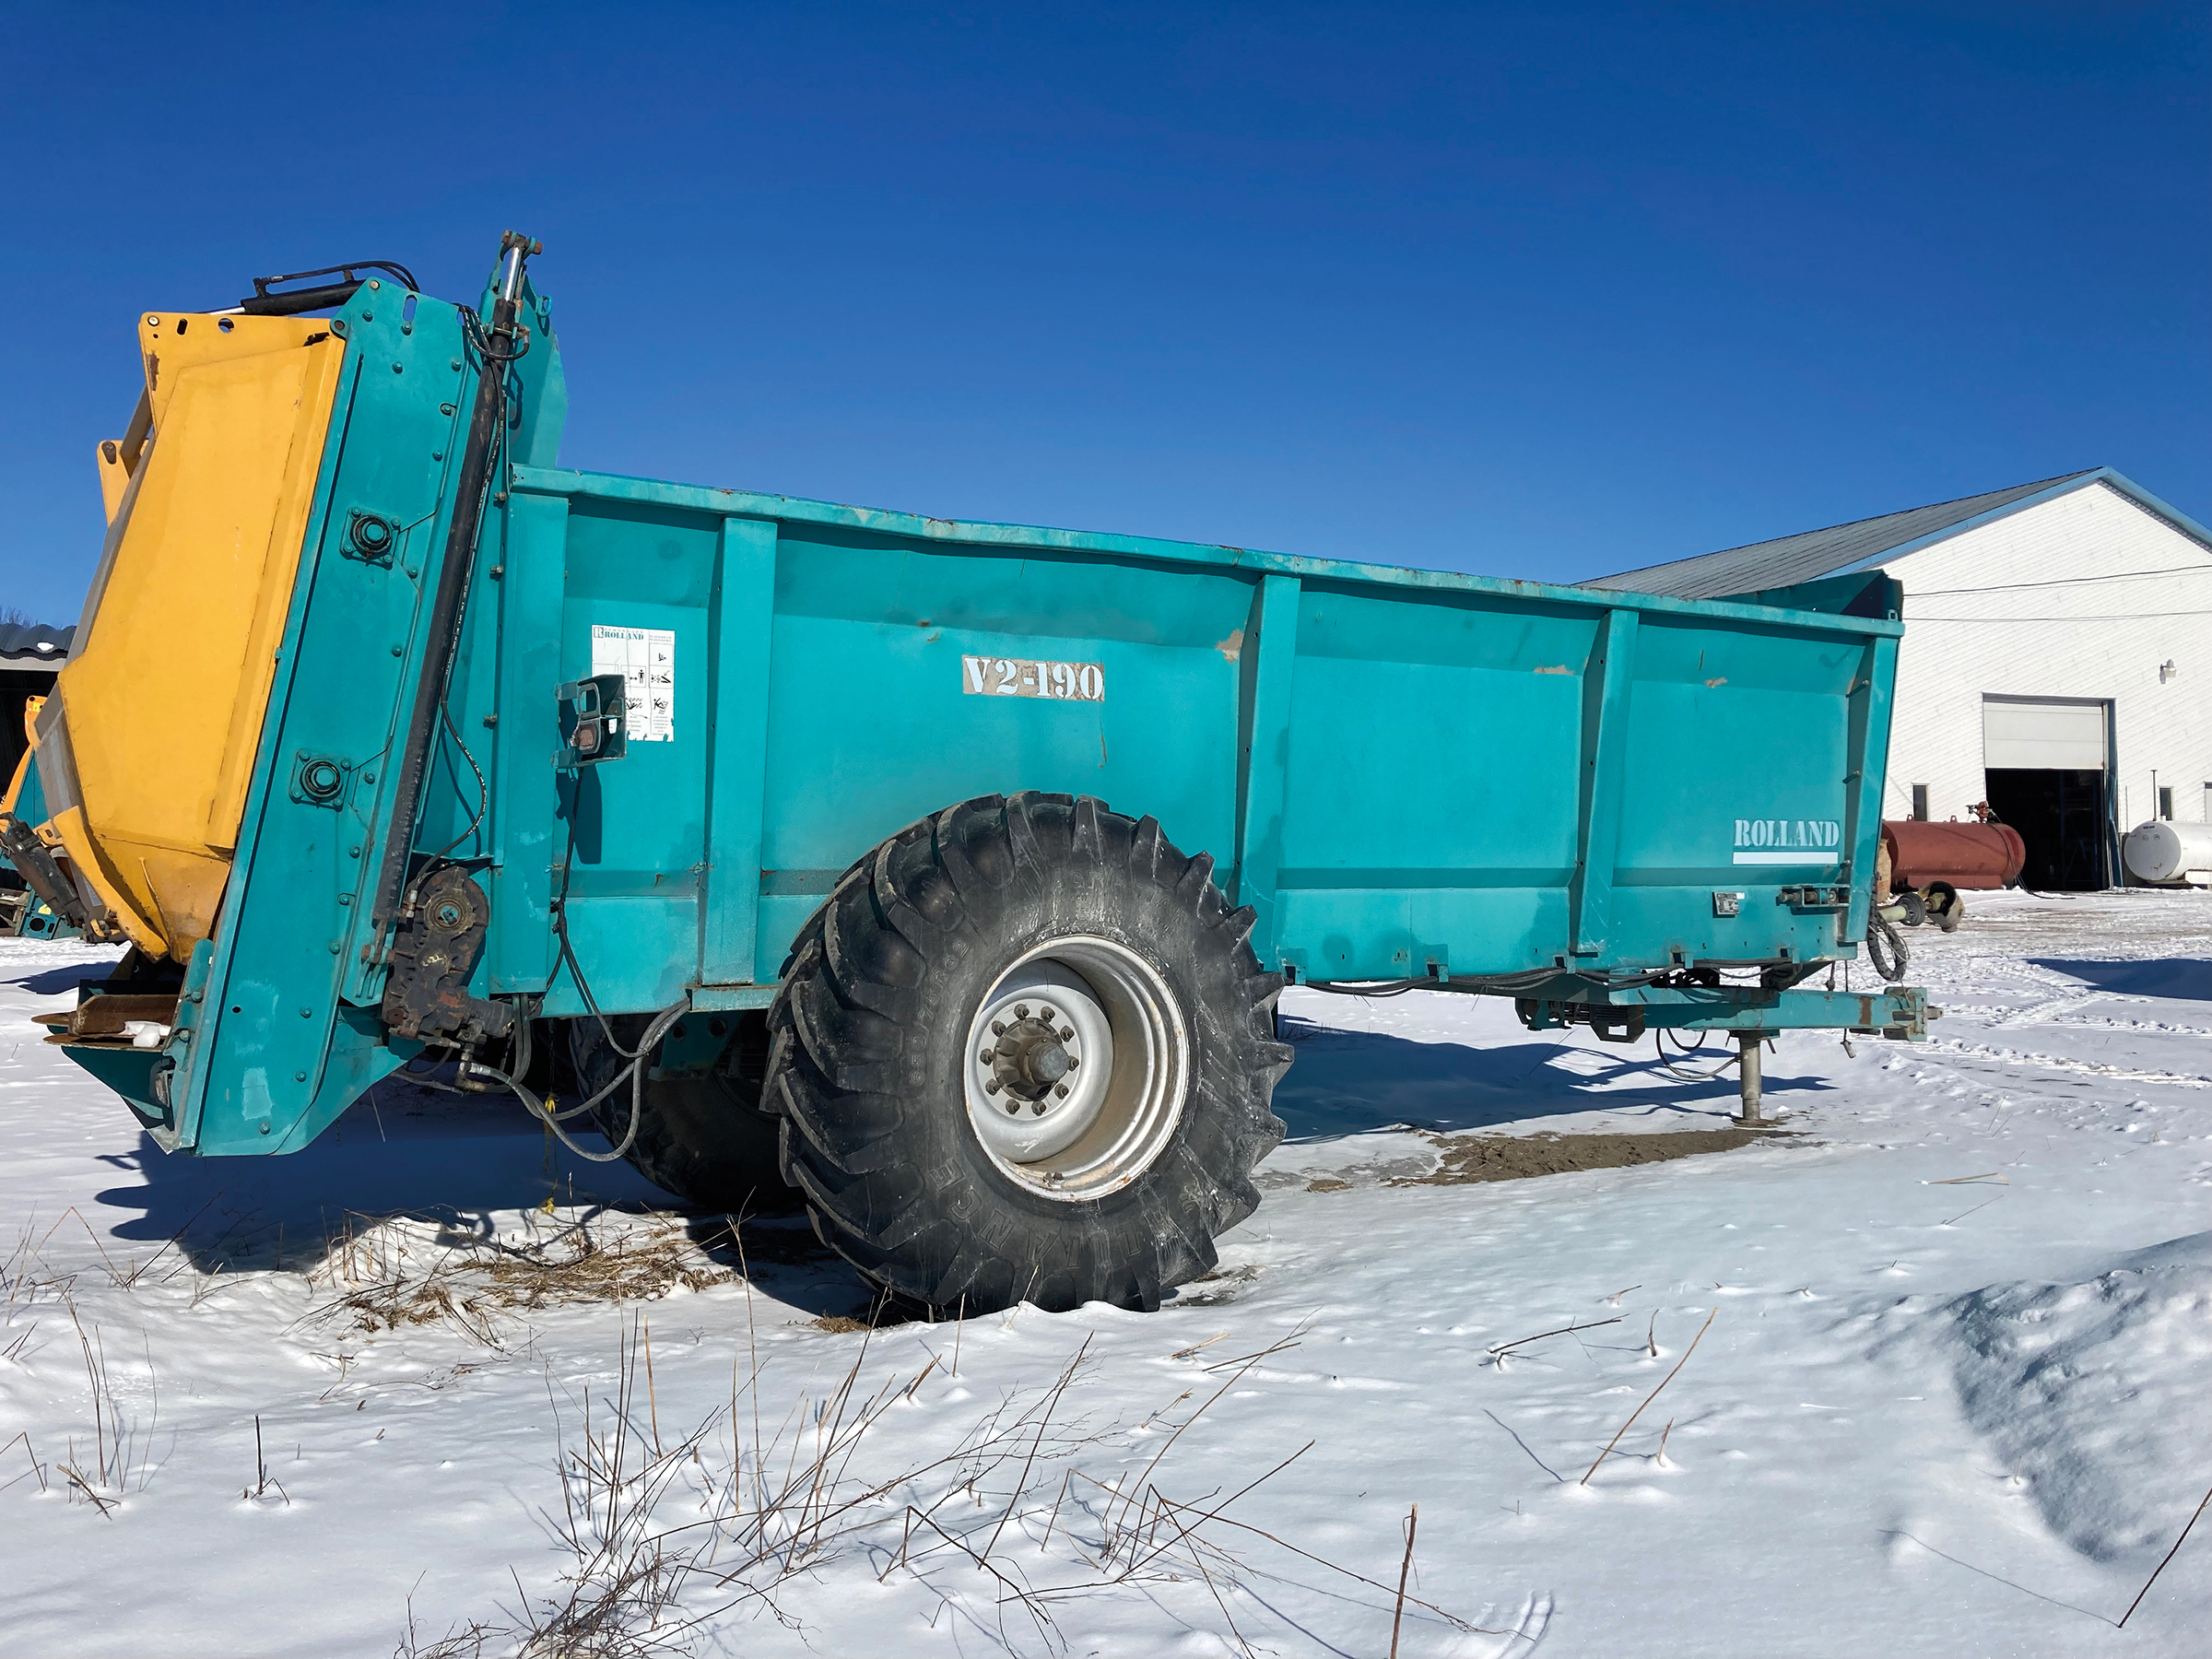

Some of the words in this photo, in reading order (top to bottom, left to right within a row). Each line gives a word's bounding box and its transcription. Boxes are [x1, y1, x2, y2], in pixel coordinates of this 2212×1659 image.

[605, 631, 644, 641] ROLLAND
[964, 657, 1103, 700] V2-190
[1734, 818, 1840, 847] ROLLAND
[909, 937, 969, 1086] 650/75R32
